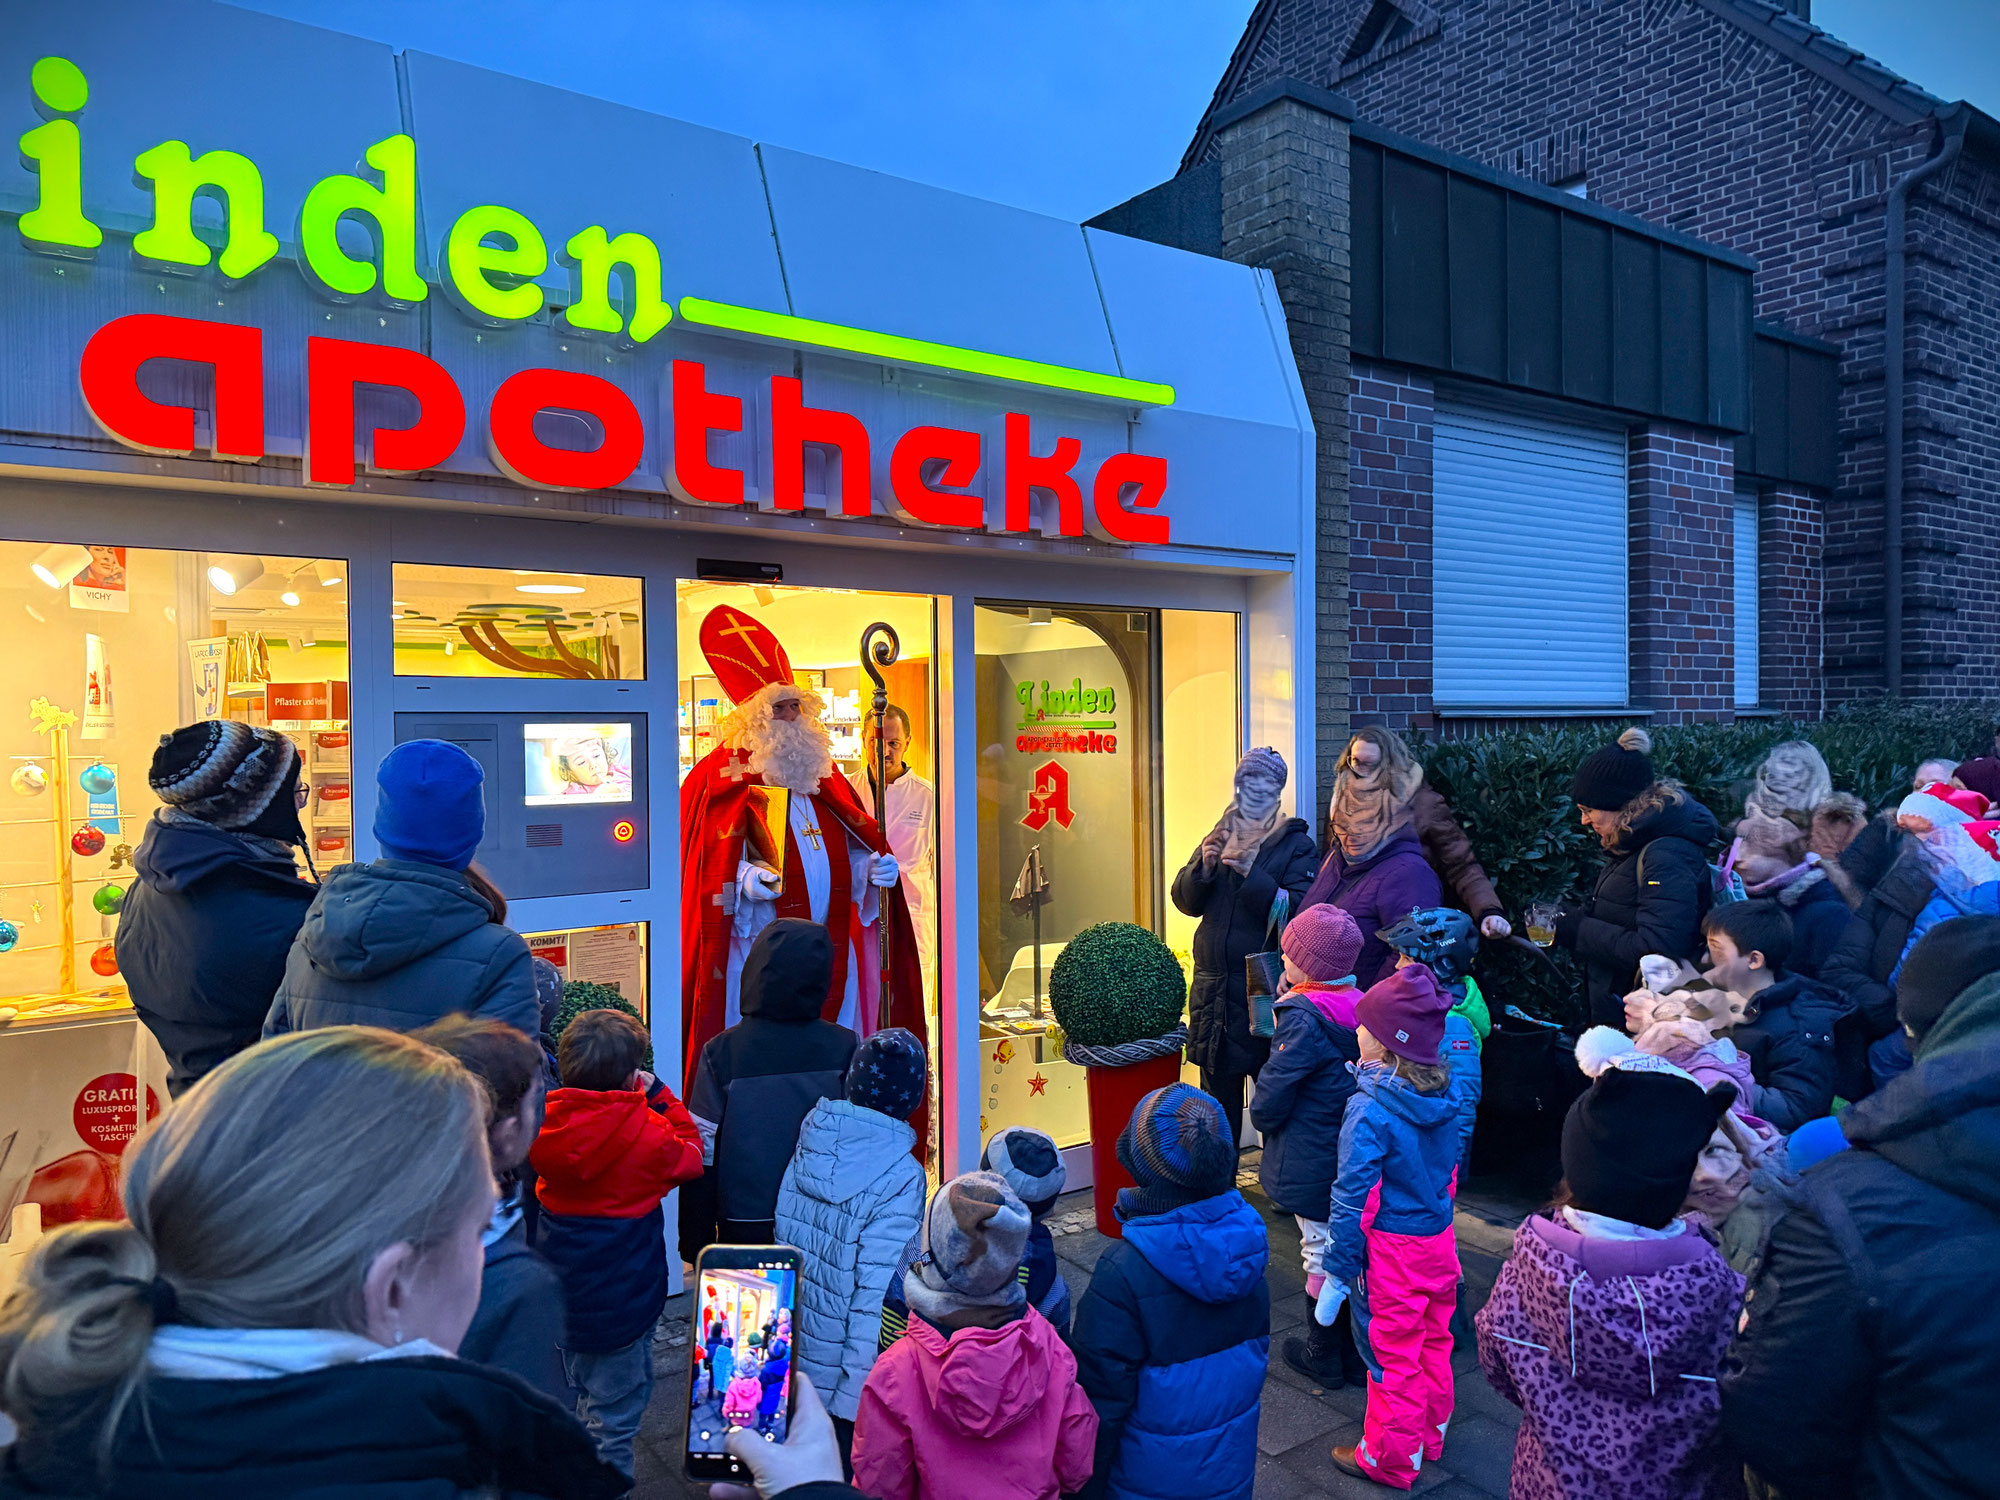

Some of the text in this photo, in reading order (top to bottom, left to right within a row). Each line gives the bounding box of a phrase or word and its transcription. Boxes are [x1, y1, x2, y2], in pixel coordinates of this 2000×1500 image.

[18, 57, 674, 344] inden
[80, 313, 1171, 545] apotheke
[86, 591, 112, 601] VICHY
[275, 697, 302, 706] Pflaster
[303, 697, 314, 706] und
[1016, 678, 1116, 718] Linden
[1016, 730, 1116, 754] apotheke
[530, 935, 566, 947] KOMMT!
[1439, 937, 1456, 947] uvex
[82, 1104, 150, 1114] LUXUSPROBN
[99, 1132, 135, 1142] TASCHE
